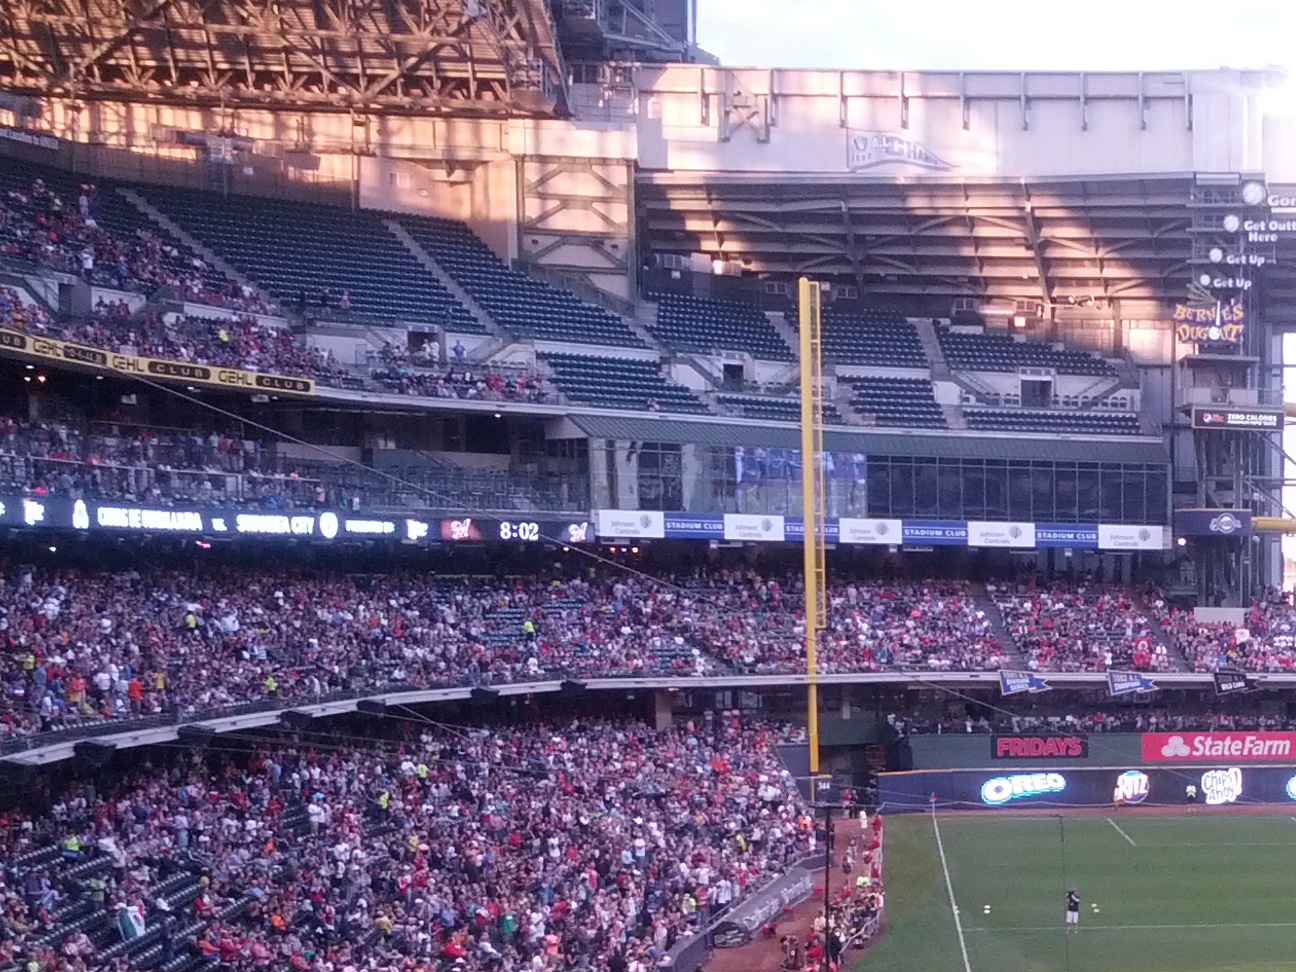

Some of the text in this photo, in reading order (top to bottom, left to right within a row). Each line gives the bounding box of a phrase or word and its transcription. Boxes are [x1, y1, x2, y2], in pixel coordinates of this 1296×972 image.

[1244, 220, 1266, 231] Get
[1248, 232, 1278, 242] Here
[1226, 254, 1265, 267] Get Up
[1213, 278, 1252, 290] Get Up
[112, 354, 204, 378] GEHL CLUB
[218, 370, 304, 390] GEHL CLUB
[1227, 413, 1245, 421] ZERO
[500, 521, 539, 541] 8:02
[666, 521, 723, 531] STADIUM CLUB
[903, 528, 967, 538] STADIUM CLUB
[1036, 532, 1074, 540] STADIUM
[996, 737, 1083, 757] FRIDAYS
[984, 773, 1065, 804] OREO
[1116, 774, 1148, 801] RITZ
